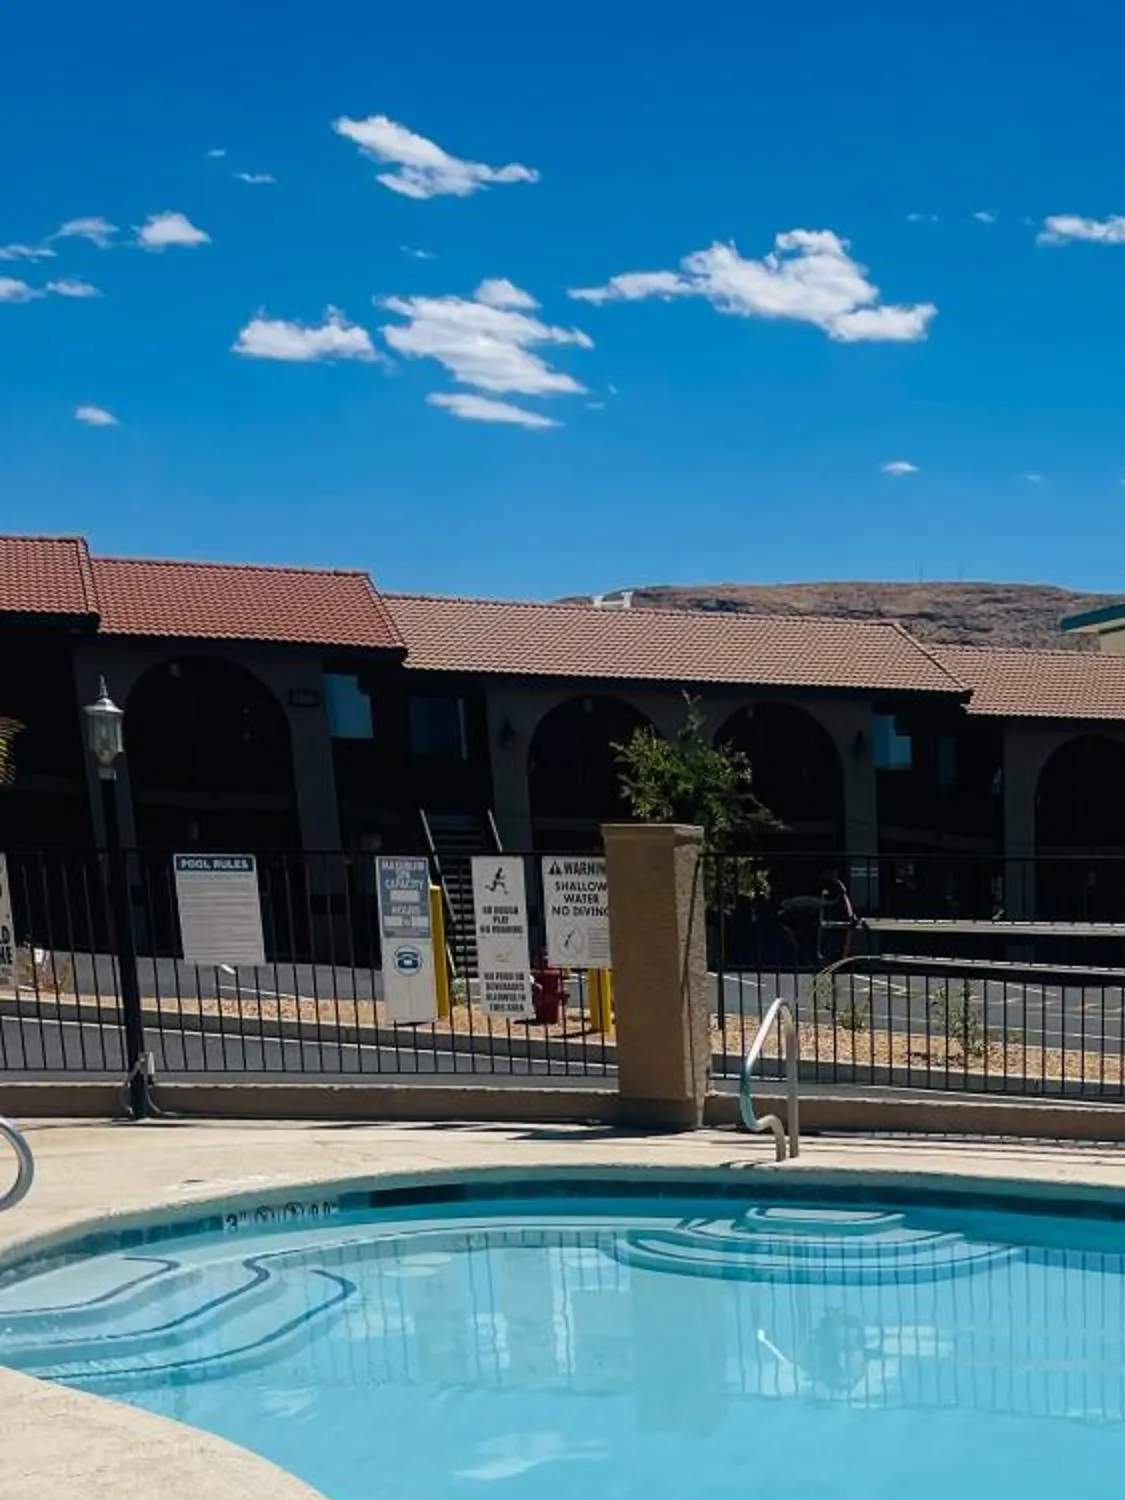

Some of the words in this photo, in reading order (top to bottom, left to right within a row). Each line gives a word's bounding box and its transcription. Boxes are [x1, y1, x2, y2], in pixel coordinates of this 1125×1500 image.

[180, 858, 211, 869] POOL
[213, 858, 249, 869] RULES
[563, 862, 606, 875] WARNIN
[555, 881, 608, 892] SHALLOW
[563, 893, 600, 905] WATER
[551, 906, 570, 916] NO
